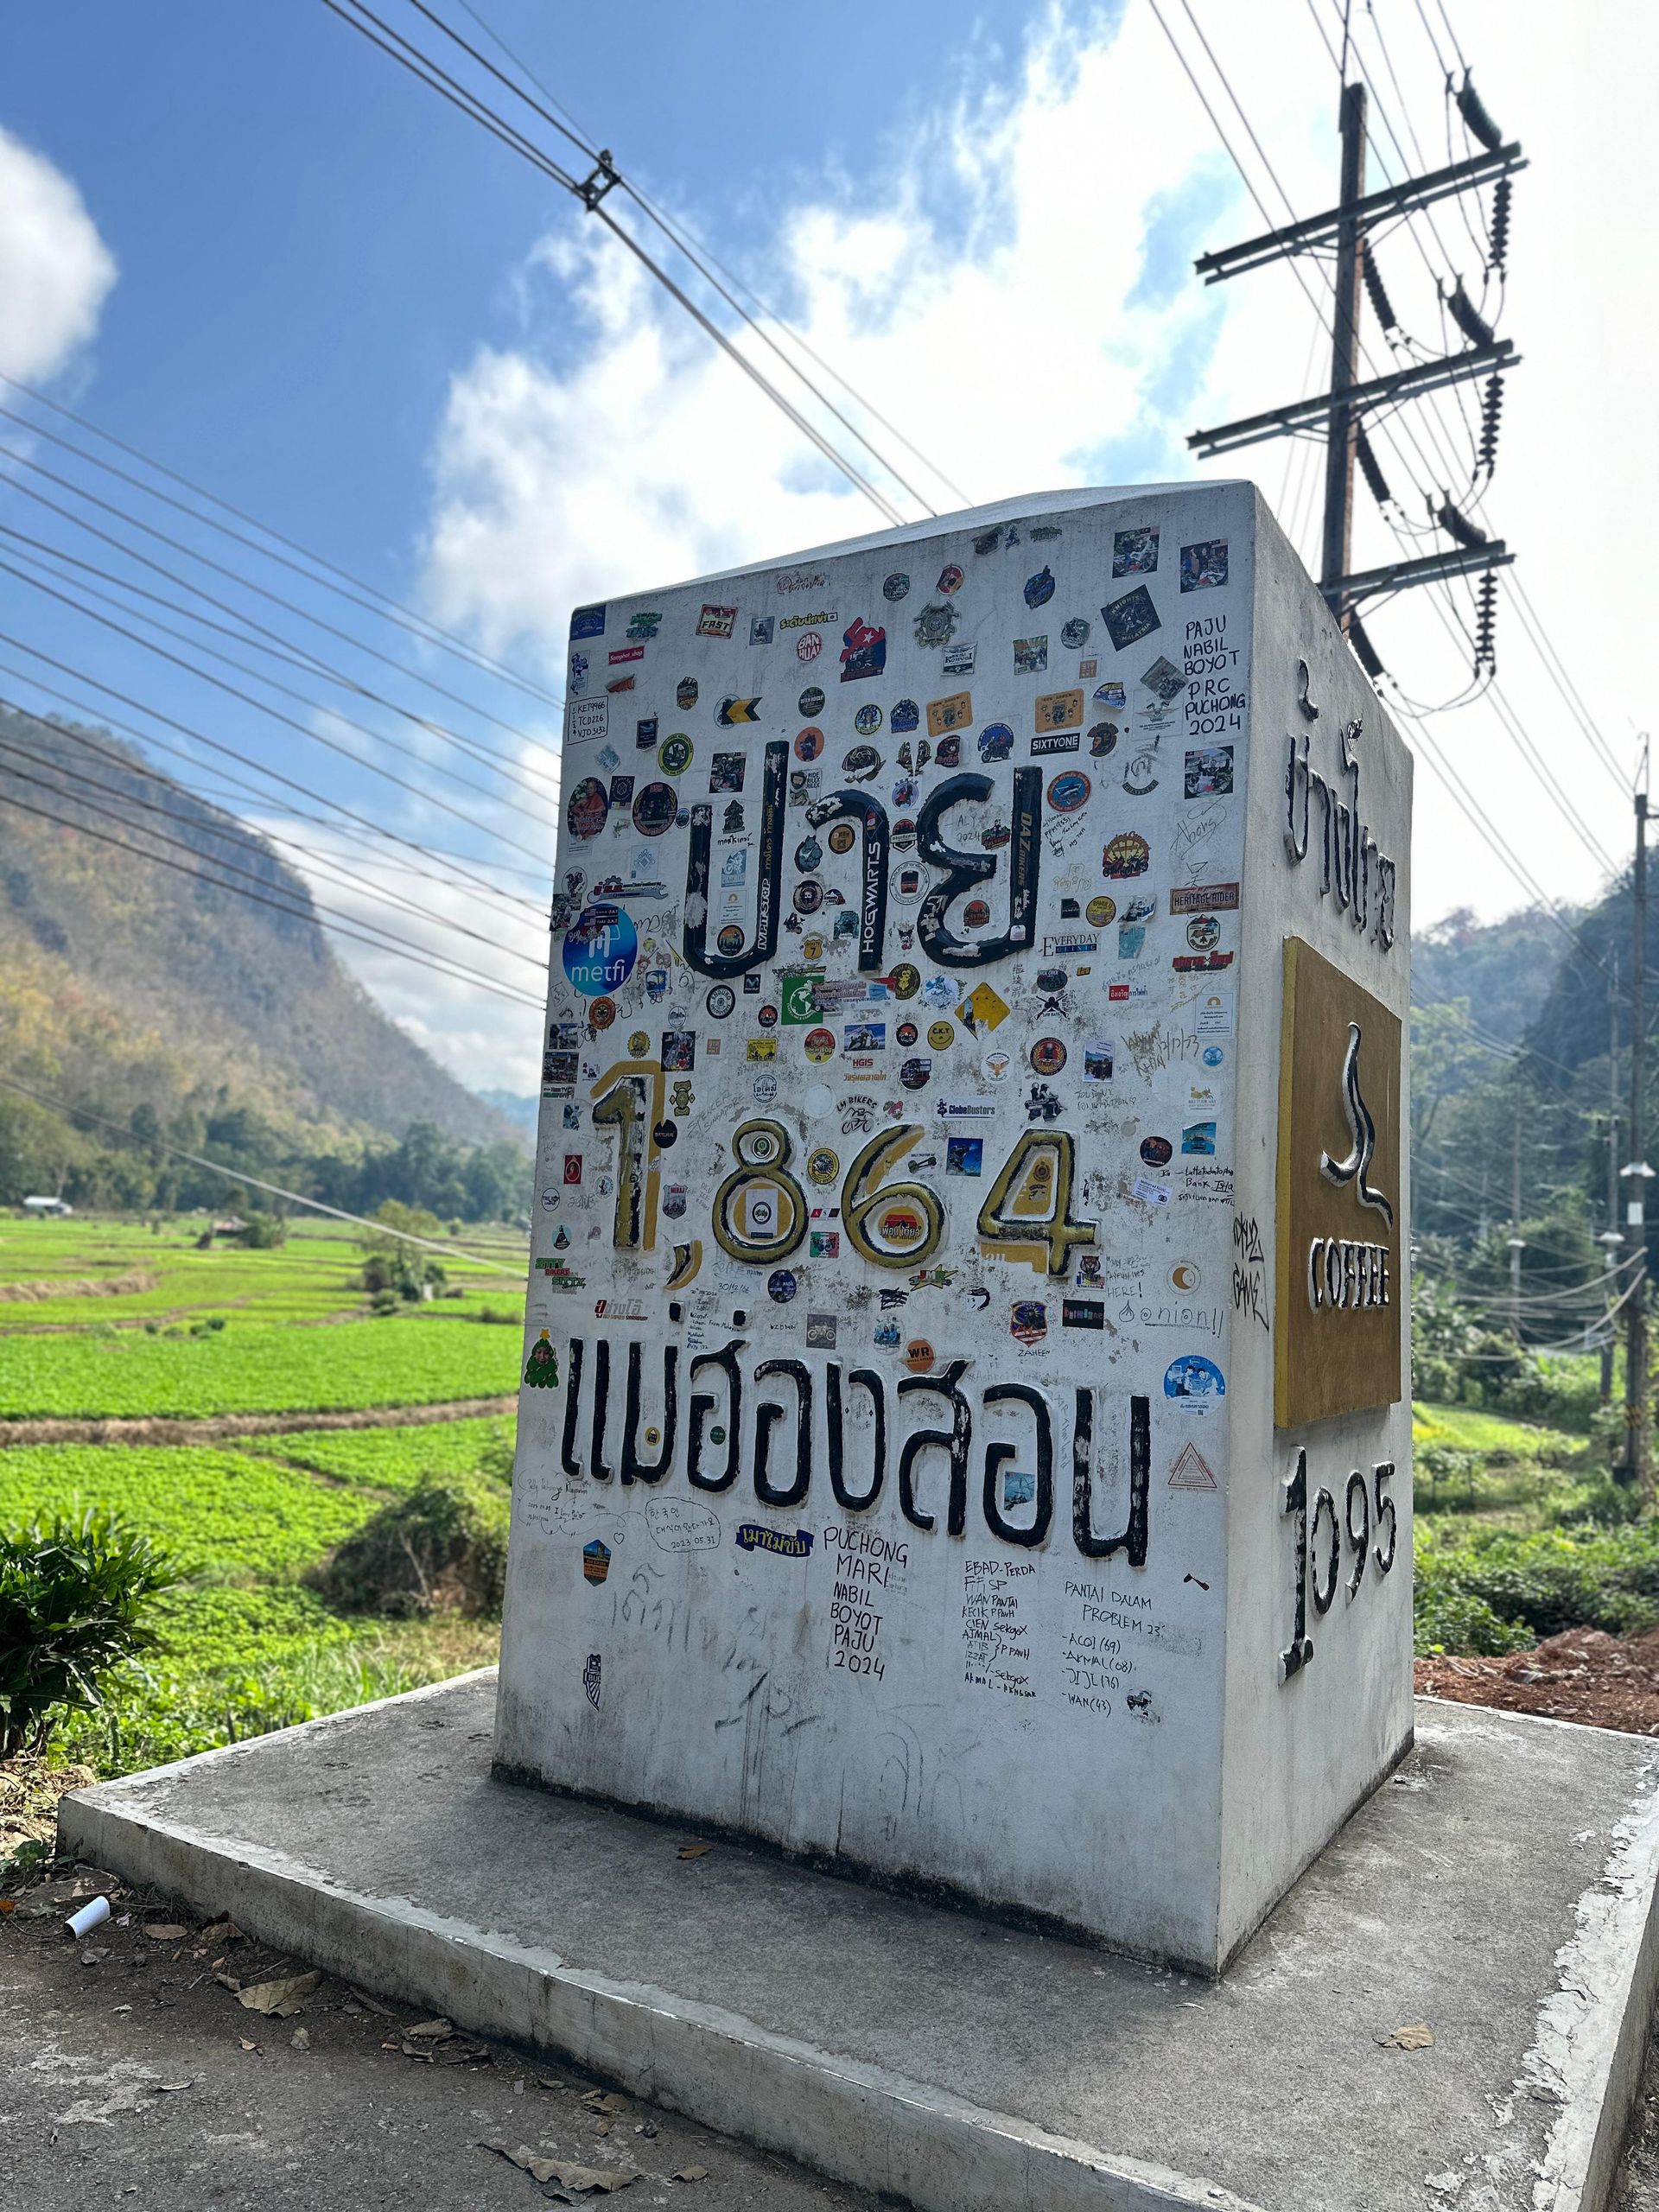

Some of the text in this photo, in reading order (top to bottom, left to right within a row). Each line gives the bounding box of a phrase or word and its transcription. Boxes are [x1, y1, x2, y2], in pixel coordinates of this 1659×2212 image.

[701, 620, 731, 632] FAST
[1122, 621, 1151, 642] MALAYSIA
[1185, 614, 1226, 640] PAJU
[798, 634, 820, 648] BAN
[1183, 637, 1229, 658] NABIL
[1185, 650, 1240, 676] BOYOT
[1188, 678, 1230, 700] PRC
[1185, 693, 1245, 720] PUCHONG
[1189, 714, 1242, 736] 2024
[1032, 736, 1078, 750] SIXTYONE
[1122, 780, 1158, 795] THAILAND
[1020, 812, 1033, 853] DAZ
[683, 739, 1044, 979] ปาย
[862, 841, 881, 953] HOGWARTS
[1174, 891, 1235, 906] HERITAGE RIDER
[810, 947, 816, 957] 7
[1042, 932, 1100, 957] EVERYDAY
[1056, 943, 1096, 954] CLINIC
[849, 1096, 878, 1109] BIKERS
[949, 1105, 995, 1116] GlobeBusters
[1307, 1236, 1390, 1314] COFFEE
[1107, 1281, 1142, 1298] HERE!
[907, 1346, 931, 1358] WR
[563, 1300, 1151, 1567] แม่ฮ่องสอน
[649, 1507, 679, 1519] 한국인
[671, 1540, 690, 1550] 2023
[743, 1528, 806, 1554] เมาไม่ขับ
[824, 1526, 908, 1568] PUCHONG
[836, 1554, 889, 1588] MARI
[1279, 1444, 1396, 1687] 1095
[834, 1581, 874, 1607] NABIL
[1065, 1580, 1103, 1603] PANTAI
[830, 1603, 883, 1636] BOYOT
[1083, 1605, 1142, 1633] PROBLEM
[835, 1624, 874, 1652] PAJU
[834, 1649, 886, 1681] 2024
